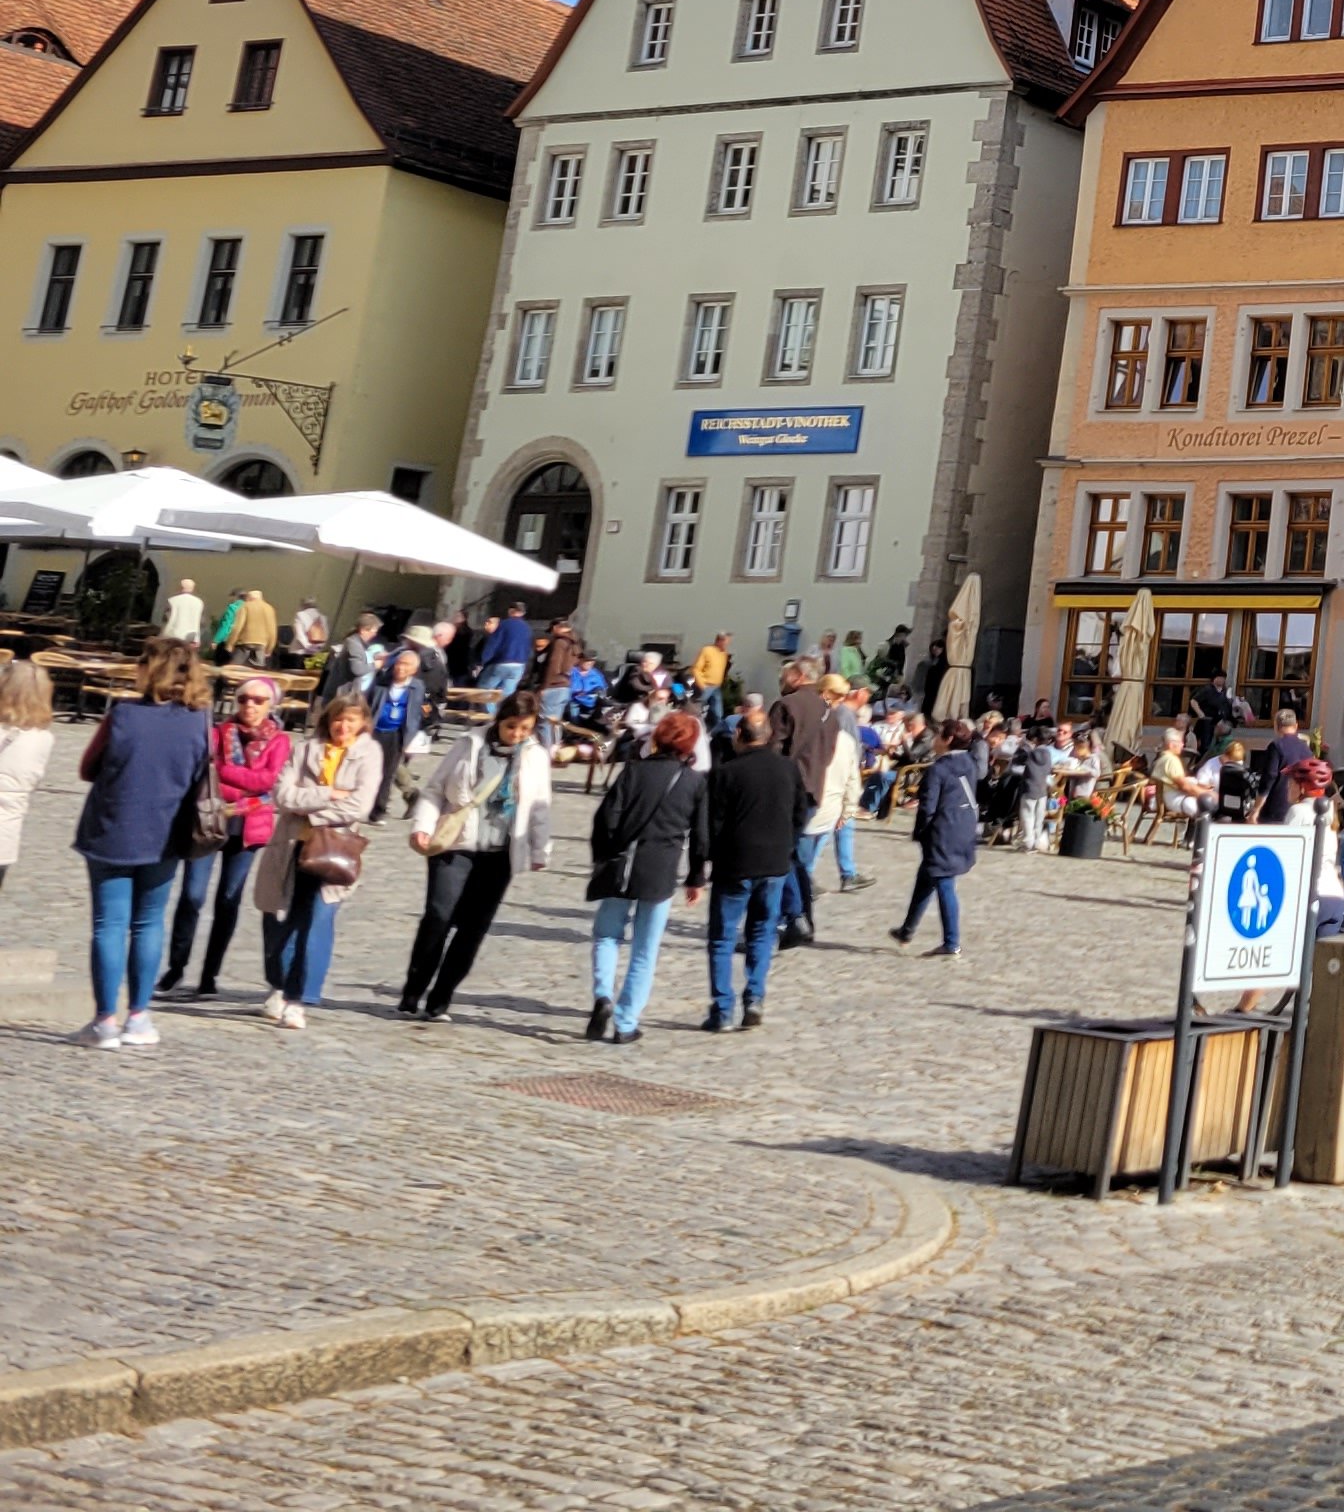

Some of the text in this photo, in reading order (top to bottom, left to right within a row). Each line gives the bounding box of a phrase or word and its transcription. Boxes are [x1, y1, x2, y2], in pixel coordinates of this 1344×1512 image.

[144, 371, 200, 386] HOTE
[1167, 425, 1264, 451] Konditorei
[1266, 423, 1329, 447] Prezel
[1227, 944, 1273, 970] ZONE
